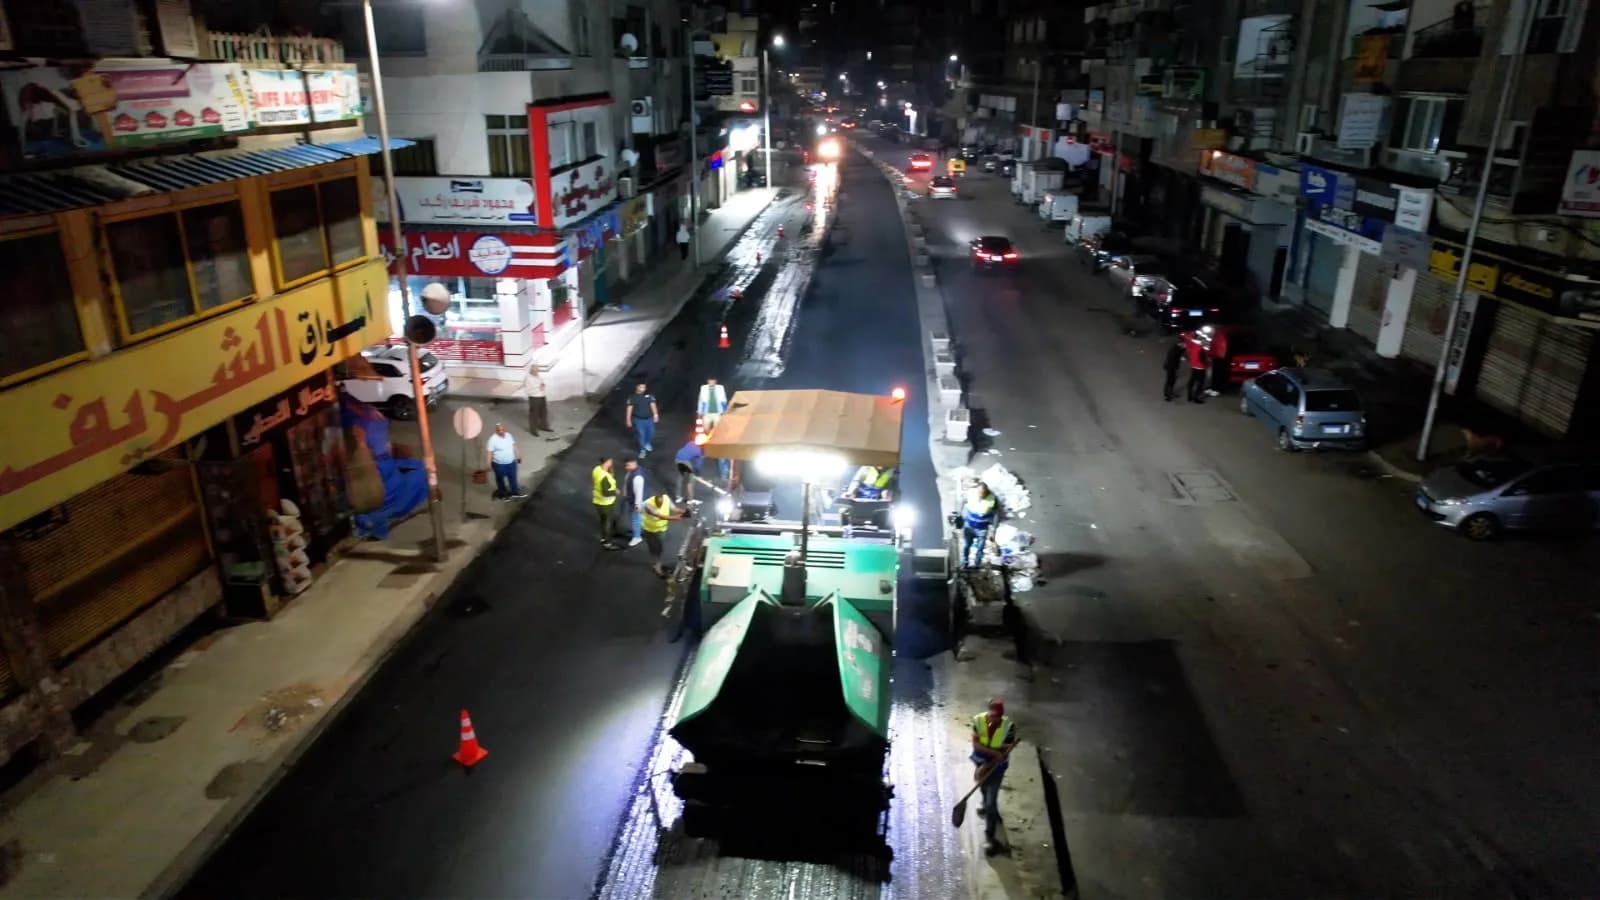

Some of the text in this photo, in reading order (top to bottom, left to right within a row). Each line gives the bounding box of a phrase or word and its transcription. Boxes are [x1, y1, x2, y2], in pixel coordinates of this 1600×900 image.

[411, 234, 460, 272] انعام
[0, 280, 374, 496] أسواق الشريف
